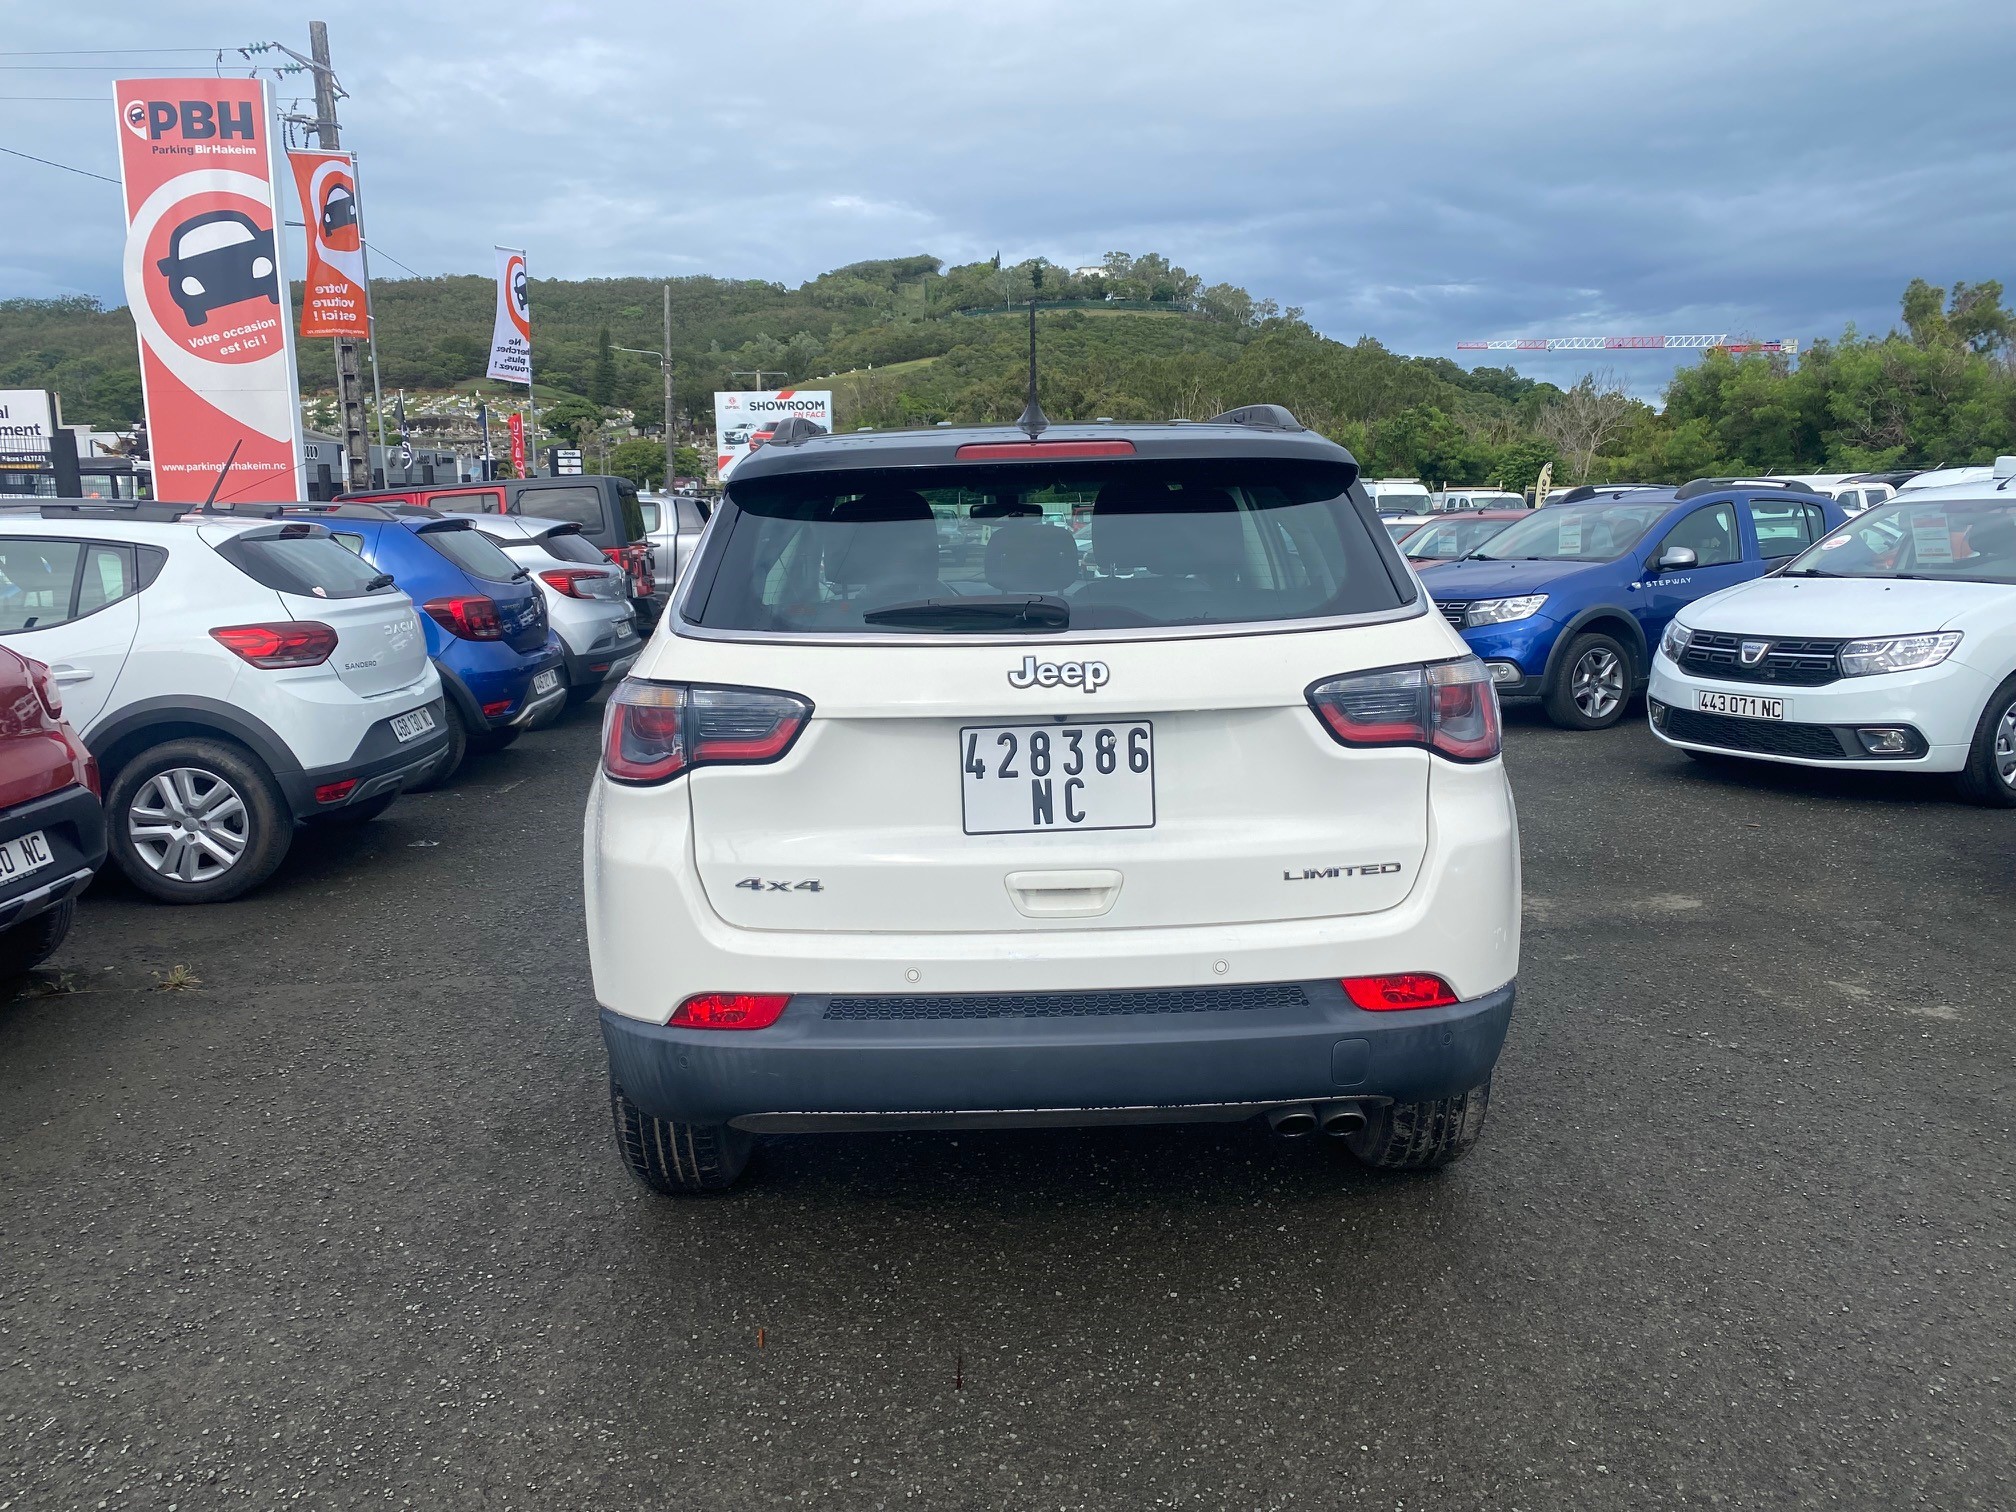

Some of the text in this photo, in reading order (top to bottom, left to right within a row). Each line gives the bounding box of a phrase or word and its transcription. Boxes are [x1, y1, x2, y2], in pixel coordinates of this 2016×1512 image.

[147, 101, 255, 140] PBH
[188, 318, 277, 348] Votre occasion
[220, 341, 241, 355] est
[243, 336, 260, 349] ici
[749, 400, 825, 411] SHOWROOM
[162, 461, 287, 473] www.parkingbrhakeim.nc
[1645, 577, 1692, 588] STEPWAY
[345, 660, 377, 670] SANDERO
[1008, 655, 1110, 694] Jeep
[1701, 693, 1781, 718] 443 071 NC
[394, 709, 433, 738] 468 130 NC
[965, 727, 1149, 780] 428386
[1031, 777, 1087, 825] NC
[19, 835, 47, 866] NC
[735, 876, 825, 892] 4x4
[1283, 862, 1402, 881] LIMITED
